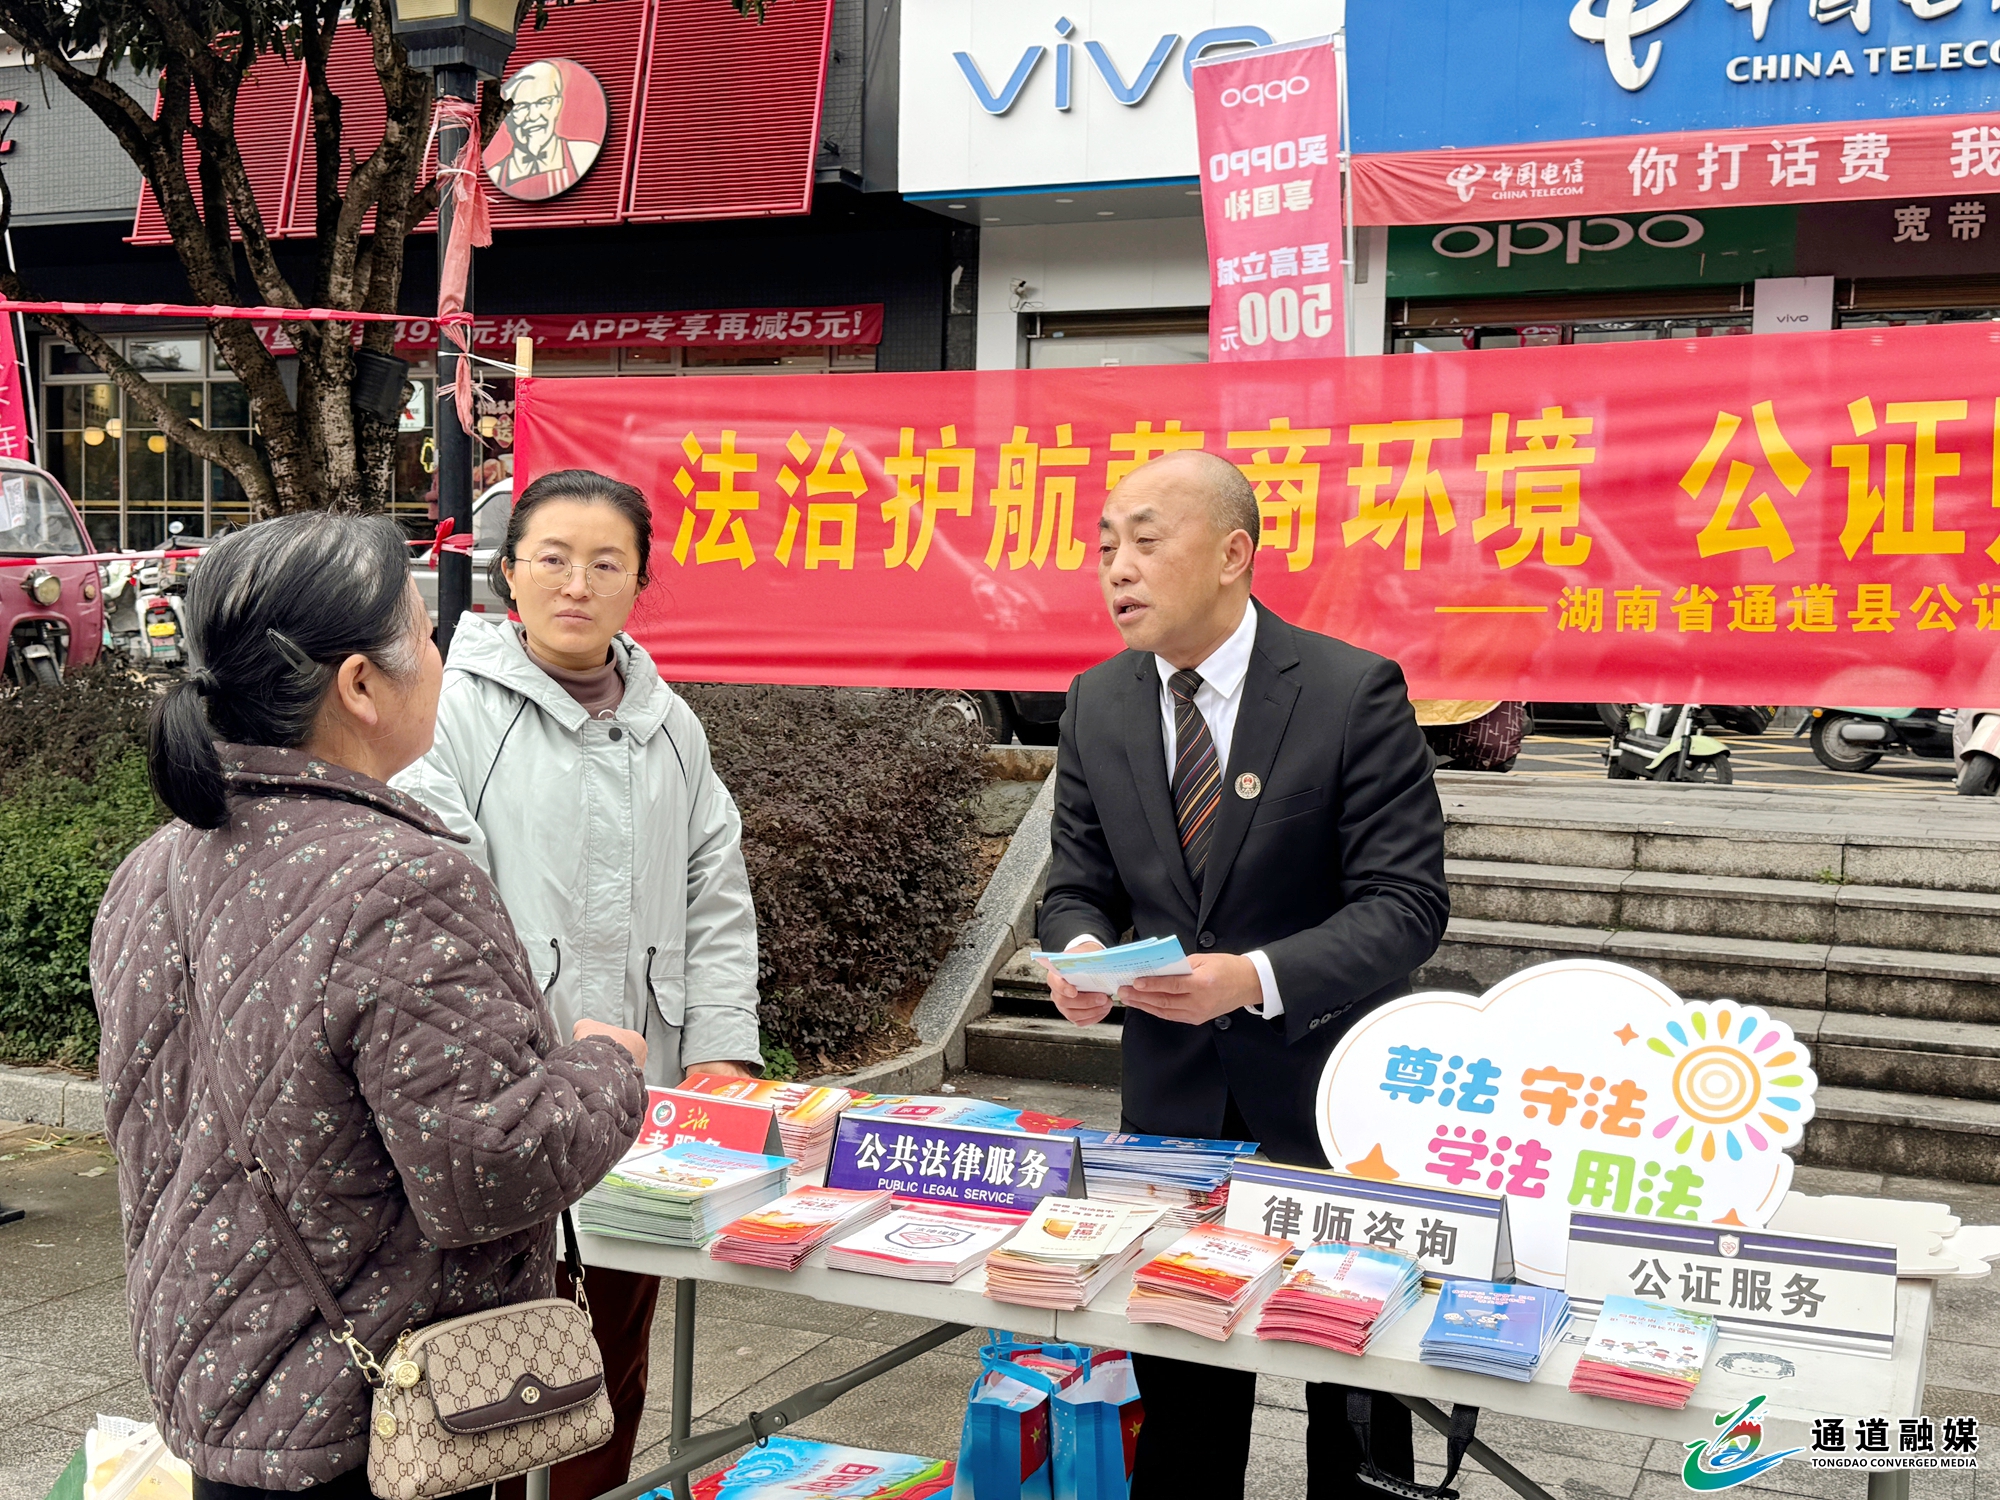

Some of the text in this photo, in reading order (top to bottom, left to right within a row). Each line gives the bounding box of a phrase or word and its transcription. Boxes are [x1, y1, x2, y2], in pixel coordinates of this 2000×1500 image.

[1726, 50, 1855, 83] CHINA
[1492, 158, 1585, 191] 中国电信
[1492, 186, 1584, 200] CHINA TELECOM
[1627, 132, 1891, 197] 你打话费
[1776, 314, 1809, 323] vivo
[1379, 1044, 1648, 1139] 尊法 守法
[854, 1132, 1050, 1190] 公共法律服务
[1425, 1124, 1704, 1222] 学法 用法
[877, 1178, 919, 1193] PUBLIC
[922, 1184, 959, 1198] LEGAL
[963, 1188, 1015, 1205] SERVICE
[1261, 1195, 1459, 1266] 律师咨询
[1628, 1258, 1827, 1319] 公证服务
